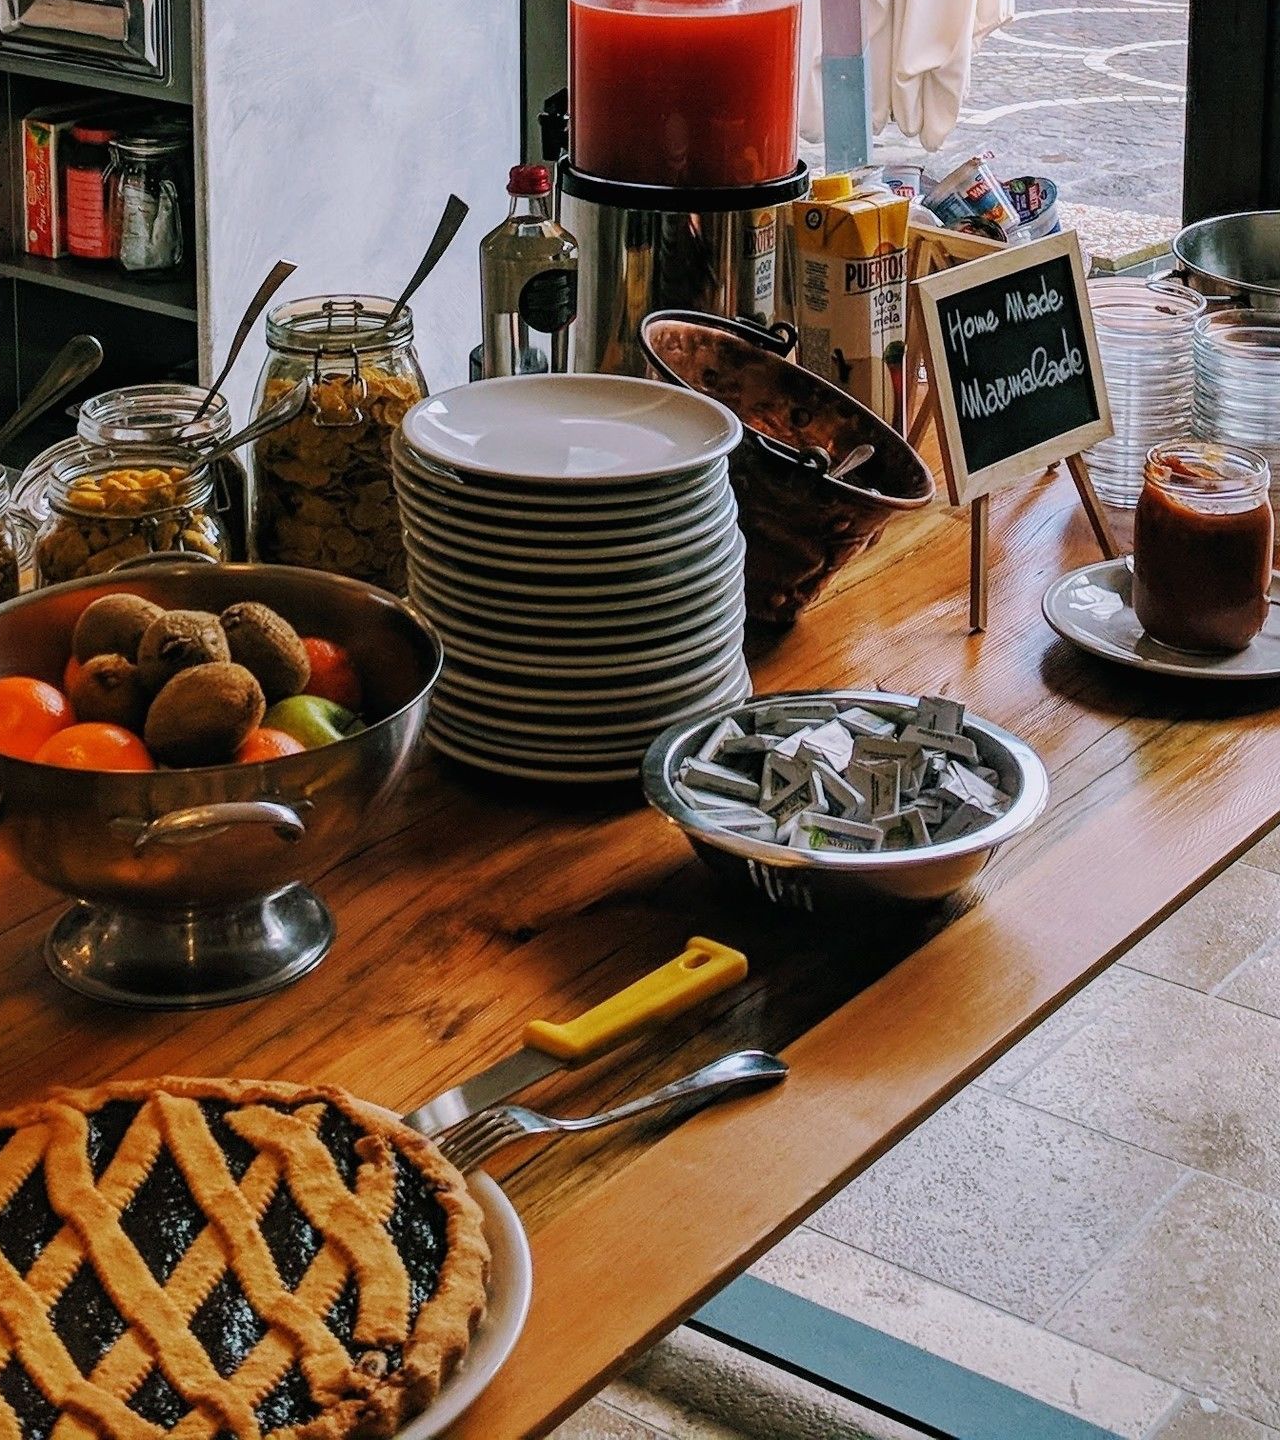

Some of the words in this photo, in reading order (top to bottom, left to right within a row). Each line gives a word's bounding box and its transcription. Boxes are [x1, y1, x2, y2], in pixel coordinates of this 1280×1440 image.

[873, 312, 900, 329] mela
[947, 308, 1000, 367] Home
[1005, 274, 1064, 323] Made
[960, 327, 1085, 420] Marmalade
